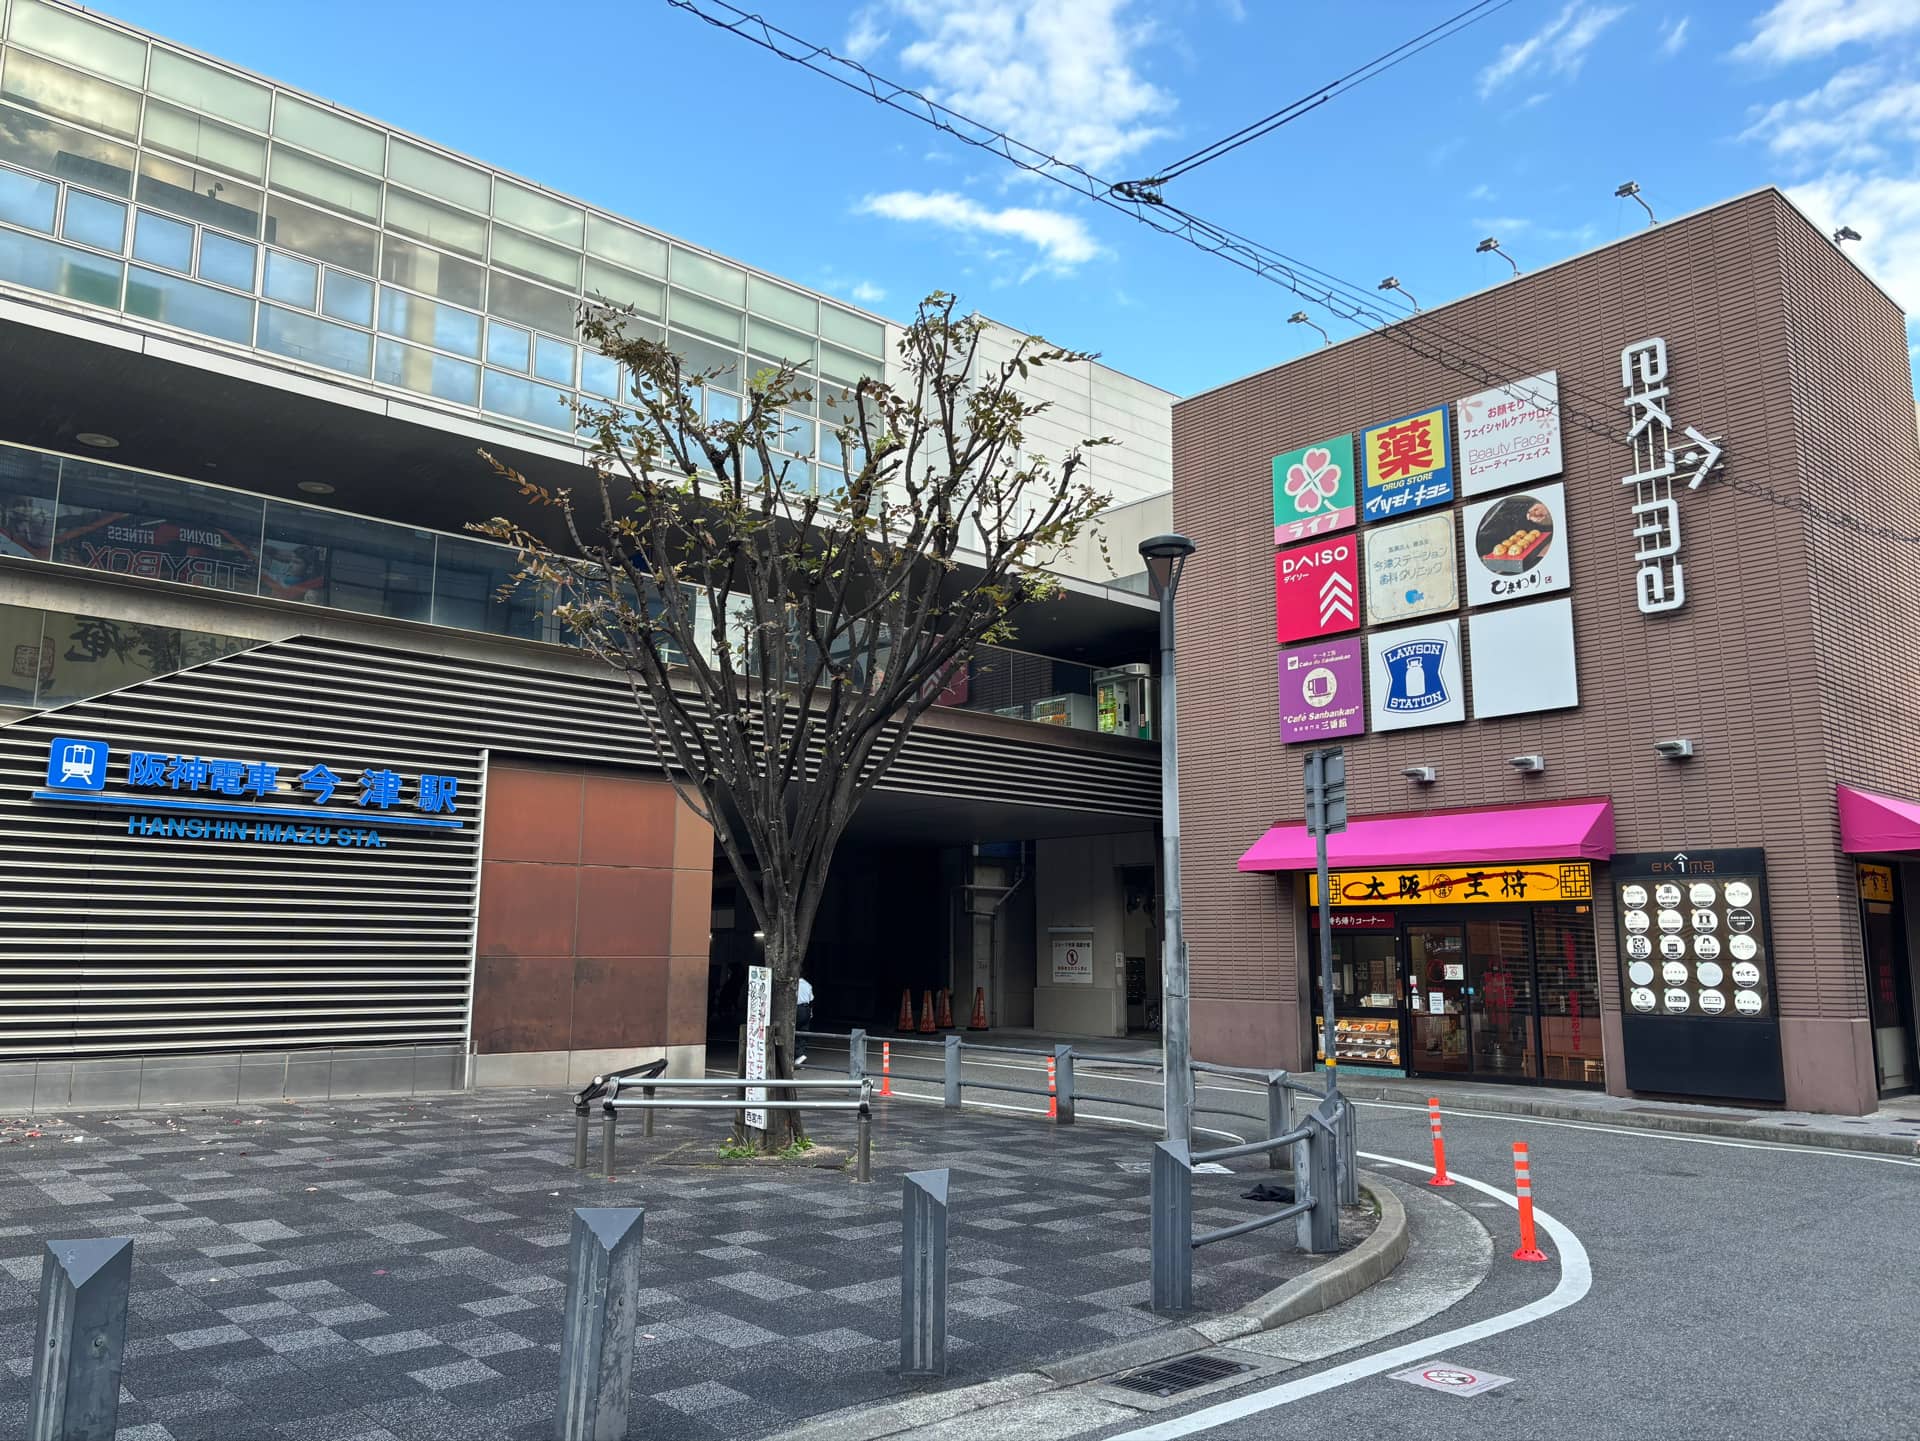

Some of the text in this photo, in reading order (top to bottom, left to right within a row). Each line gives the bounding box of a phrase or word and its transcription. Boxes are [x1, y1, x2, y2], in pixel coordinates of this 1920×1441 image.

[1463, 406, 1552, 439] フェイシャルケアサロン
[1377, 419, 1433, 480] 薬
[1468, 433, 1545, 462] Beauty Face
[1470, 447, 1551, 475] ビューティーフェイス
[1382, 472, 1433, 492] DRUG STORE
[1366, 483, 1450, 513] マツモトキヨシ
[1288, 512, 1339, 537] ライフ
[1282, 546, 1348, 574] DAISO
[1283, 573, 1309, 583] ダイソー
[1387, 643, 1441, 662] LAWSON
[1389, 690, 1442, 709] STATION
[127, 751, 280, 797] 阪神電車
[127, 815, 388, 848] HANSHIN IMAZU STA.
